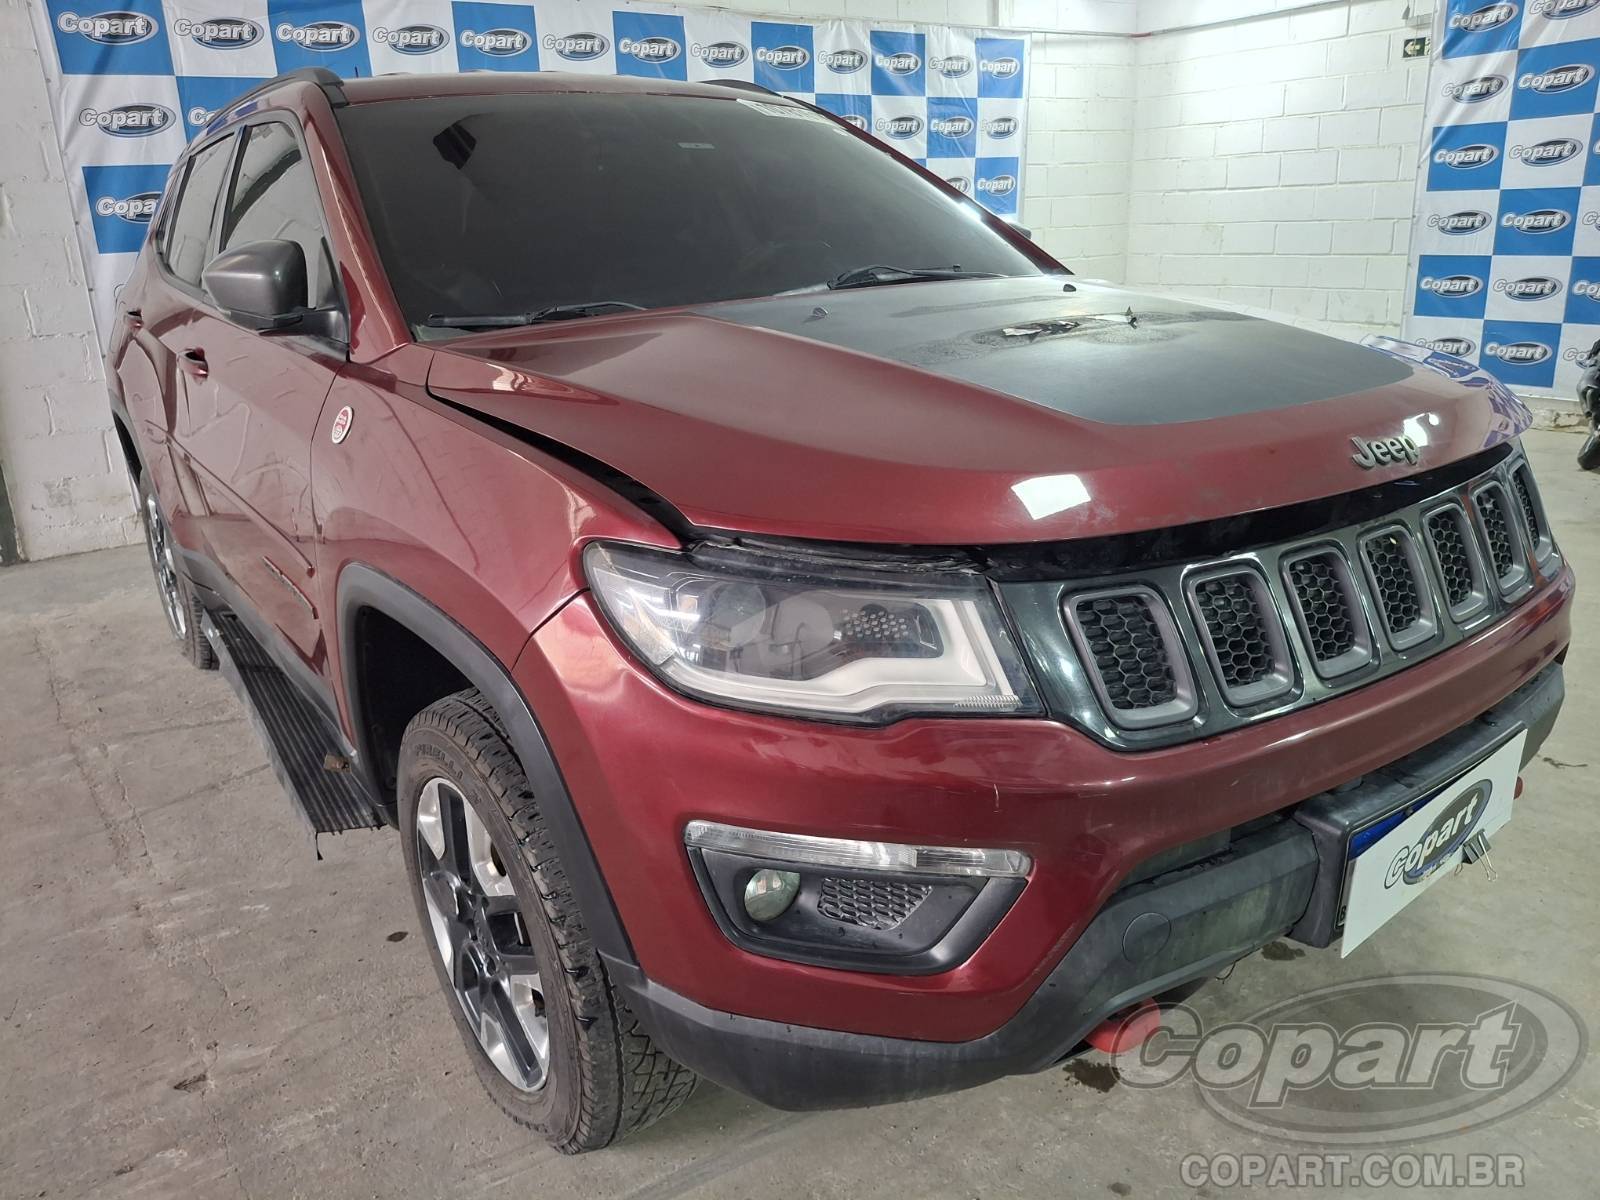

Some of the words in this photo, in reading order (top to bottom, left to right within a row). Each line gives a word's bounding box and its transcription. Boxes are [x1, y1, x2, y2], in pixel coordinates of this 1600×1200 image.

[58, 12, 146, 37] Copart
[1450, 7, 1508, 28] Copart
[174, 18, 252, 42] Copart
[277, 24, 349, 44] Copart
[373, 27, 440, 46] Copart
[460, 30, 523, 50] Copart
[543, 34, 600, 53] Copart
[619, 39, 674, 57] Copart
[690, 43, 742, 62] Copart
[756, 48, 806, 65] Copart
[818, 52, 862, 69] Copart
[875, 54, 916, 71] Copart
[929, 57, 968, 73] Copart
[979, 60, 1016, 73] Copart
[1518, 67, 1588, 90] Copart
[1441, 79, 1503, 100] Copart
[79, 108, 163, 131] Copart
[875, 117, 917, 137] Copart
[930, 118, 969, 135] Copart
[1434, 148, 1492, 165] Copart
[1509, 143, 1575, 163] Copart
[977, 177, 1013, 194] Copart
[96, 196, 158, 219] Copa
[1427, 214, 1483, 231] Copart
[1502, 213, 1563, 231] Copart
[1421, 276, 1475, 293] Copart
[1493, 279, 1553, 296] Copart
[1485, 342, 1543, 360] Copart
[1350, 436, 1420, 469] Jeep
[1384, 792, 1478, 889] Copart
